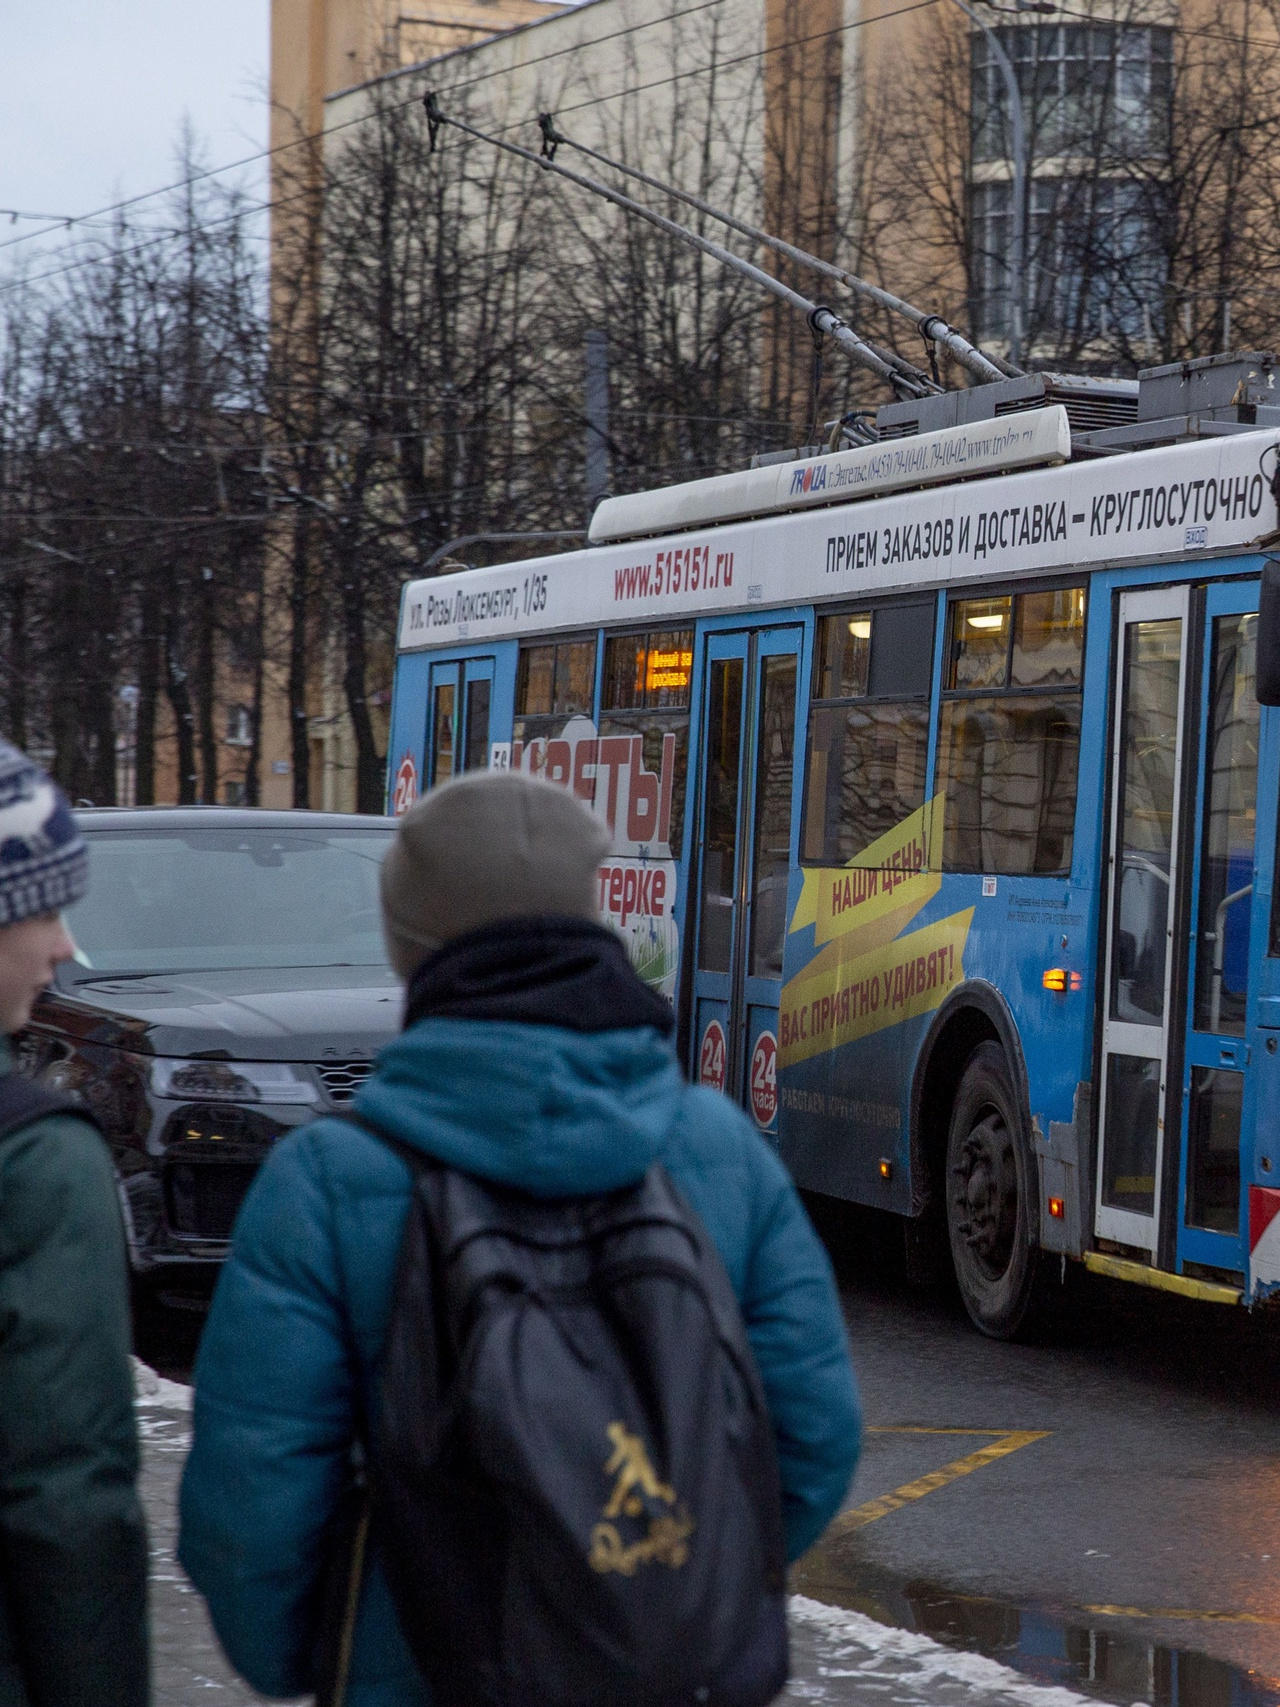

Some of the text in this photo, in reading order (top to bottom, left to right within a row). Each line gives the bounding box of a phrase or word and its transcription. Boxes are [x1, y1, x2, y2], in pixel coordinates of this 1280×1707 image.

[825, 529, 879, 573] ПРИЕМ
[881, 518, 954, 565] ЗАКАЗОВ
[958, 515, 971, 554] И
[974, 501, 1067, 560] ДОСТАВКА
[1090, 473, 1263, 537] КРУГЛОСУТОЧНО
[523, 573, 548, 618] 1/35
[614, 545, 734, 602] www.515151.ru
[831, 868, 878, 917] НАШИ
[780, 943, 955, 1048] ВАС ПРИЯТНО УДИВЯТ!
[702, 1037, 723, 1079] 24
[753, 1048, 777, 1091] 24
[754, 1091, 775, 1111] часа
